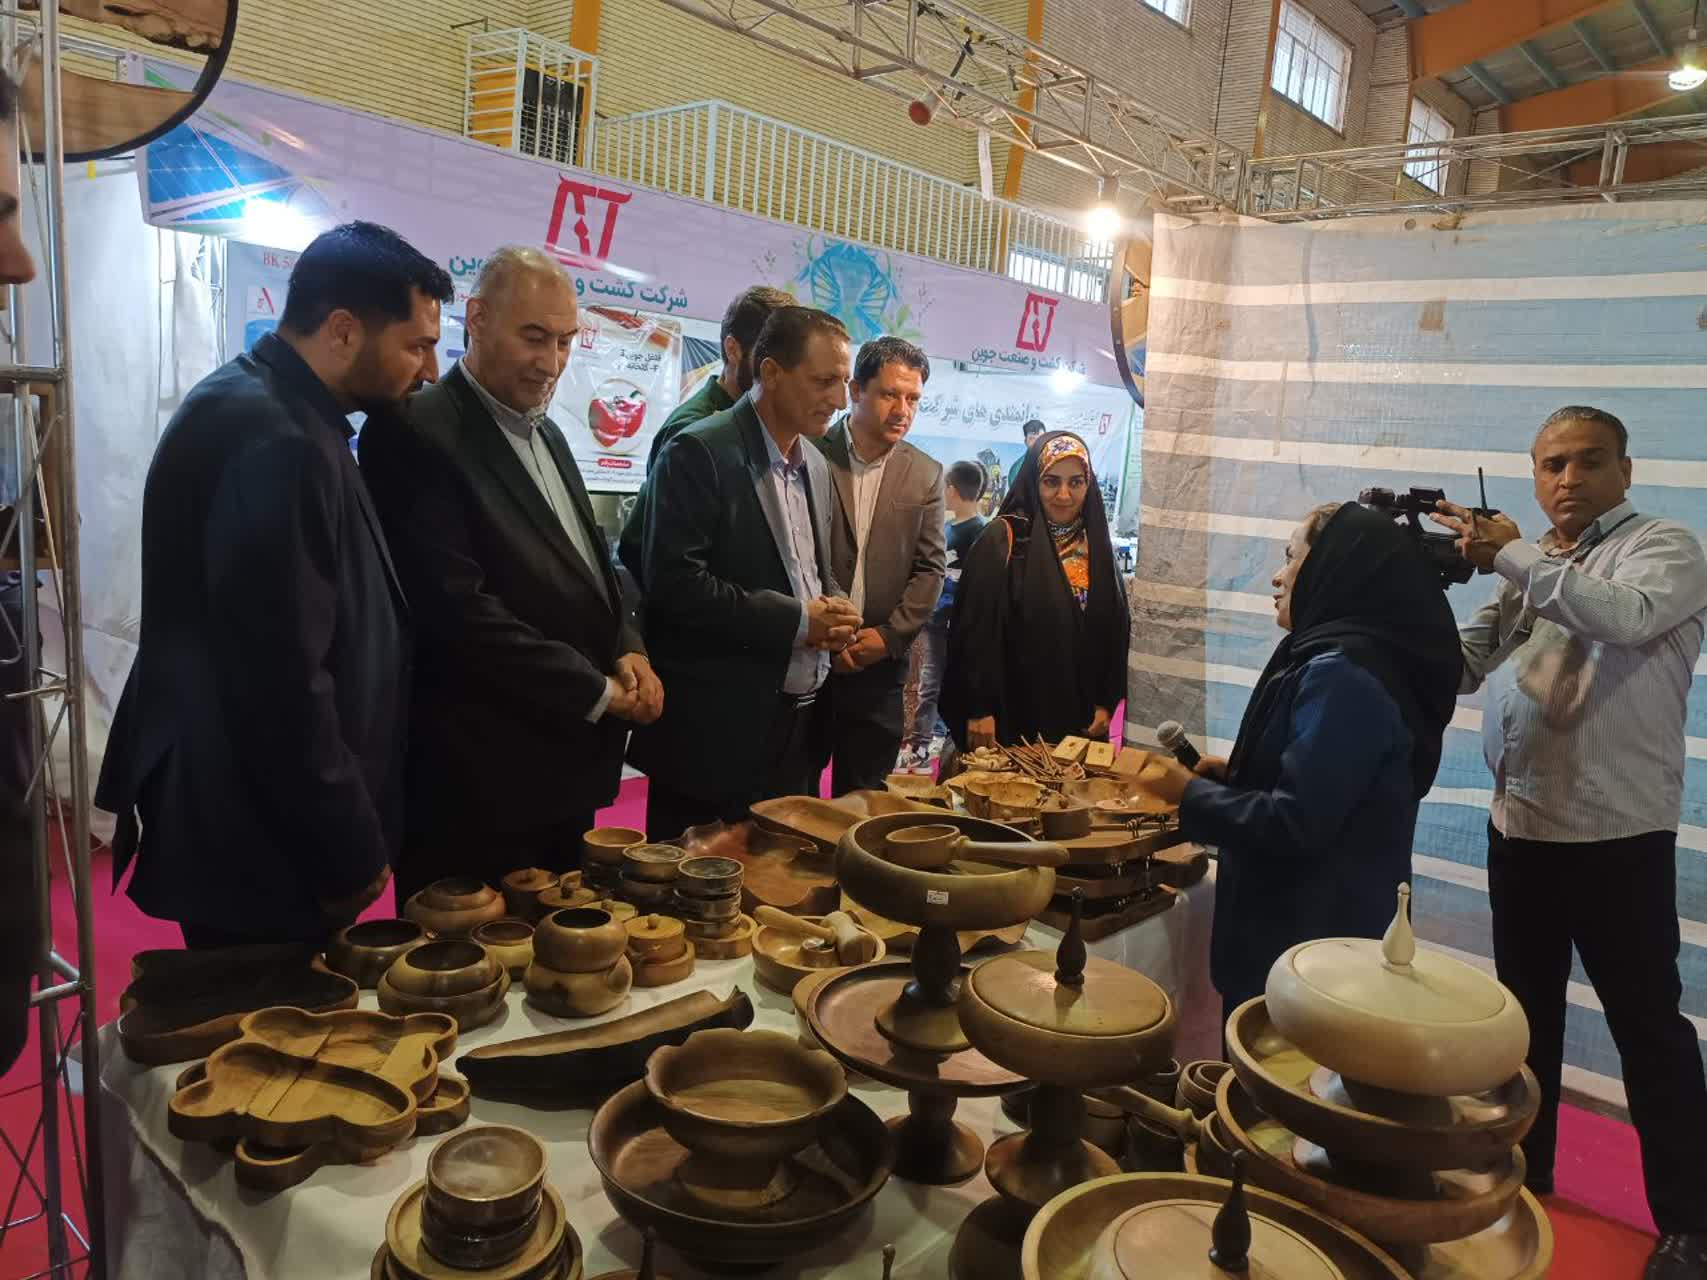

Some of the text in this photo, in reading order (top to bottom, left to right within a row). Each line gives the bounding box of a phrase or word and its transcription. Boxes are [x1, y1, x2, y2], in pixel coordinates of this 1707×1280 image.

[576, 277, 585, 296] و
[589, 279, 635, 298] کشت
[640, 284, 688, 312] شرکت
[971, 348, 997, 363] جوین
[999, 351, 1029, 365] صنعت
[1031, 357, 1037, 371] و
